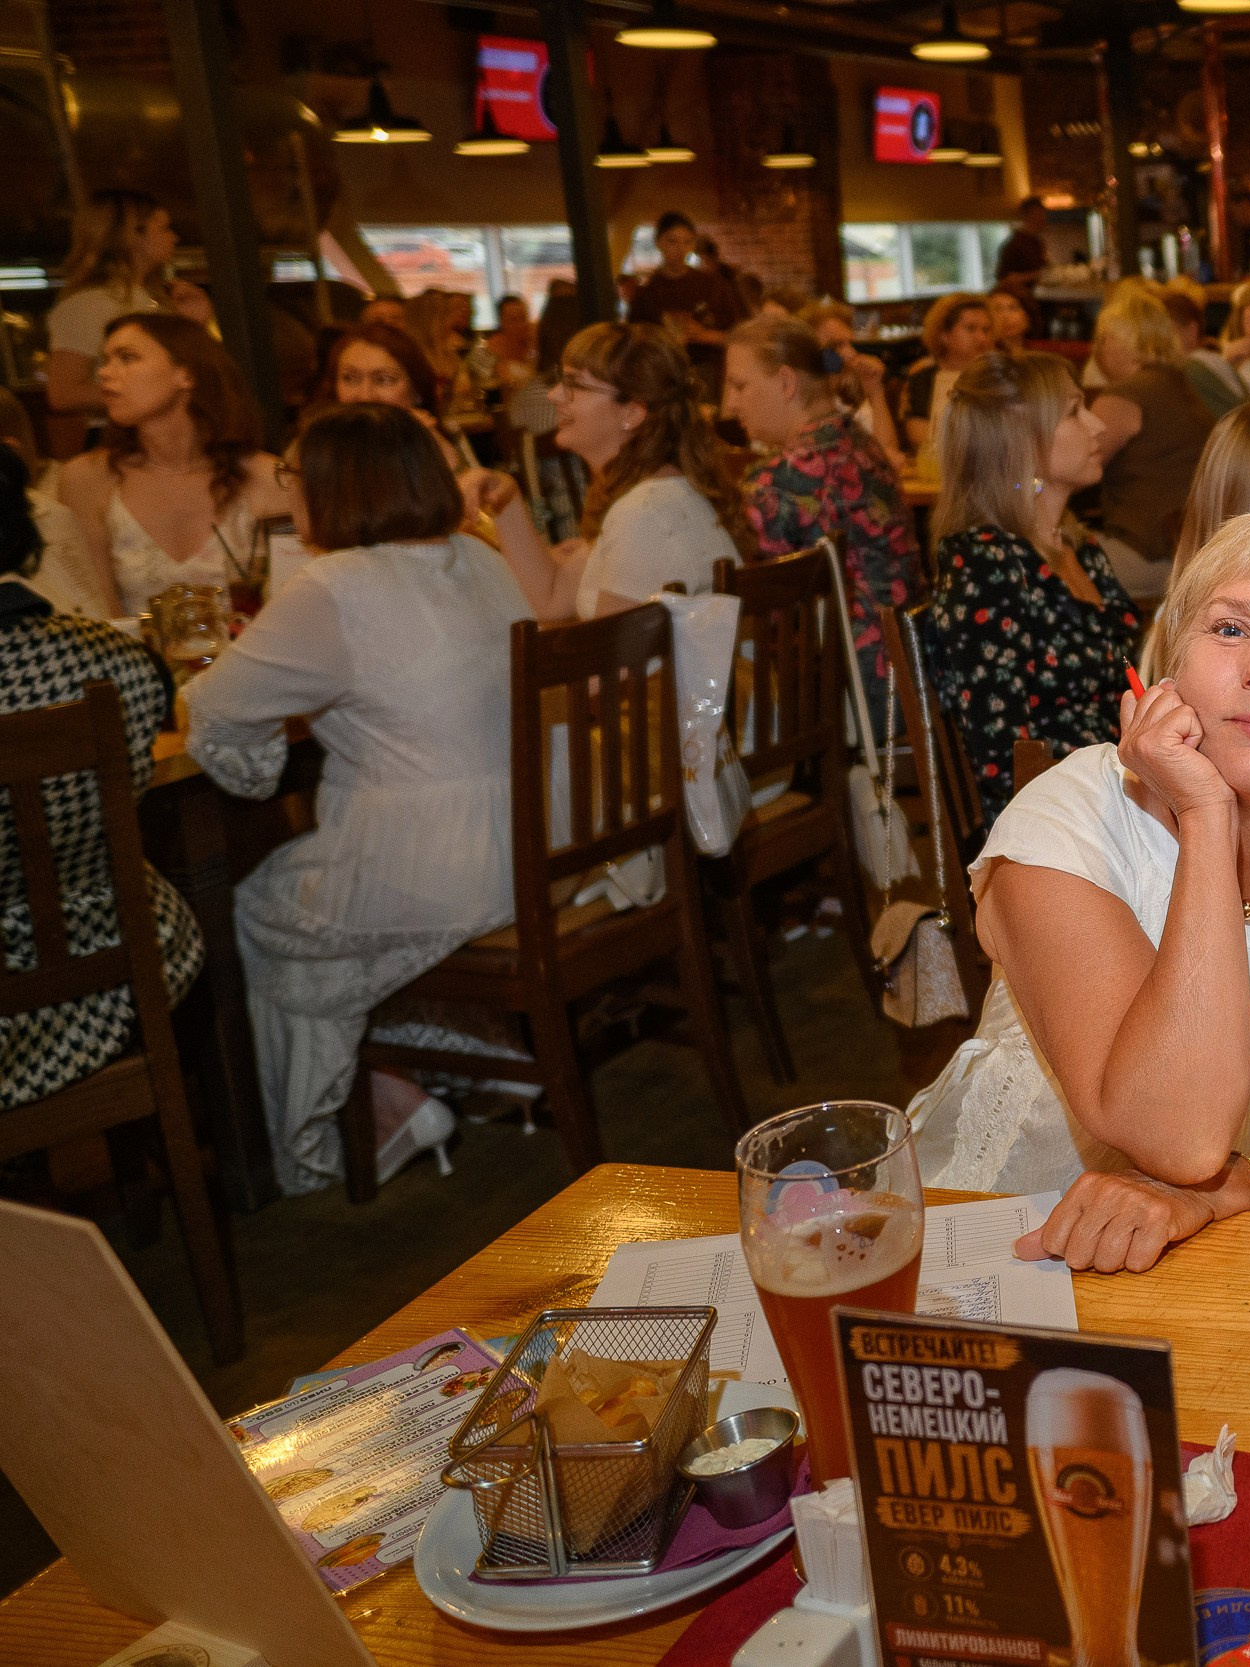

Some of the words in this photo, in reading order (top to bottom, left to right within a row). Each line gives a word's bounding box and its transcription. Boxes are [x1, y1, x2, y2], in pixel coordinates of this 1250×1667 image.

[861, 1330, 998, 1365] ВСТРЕЧАЙТЕ!
[299, 1385, 333, 1403] ПИВО
[862, 1362, 1000, 1409] СЕВЕРО-
[867, 1402, 1008, 1445] НЕМЕЦКИЙ
[874, 1437, 1017, 1504] ПИЛС
[890, 1502, 945, 1525] ЕВЕР
[953, 1506, 1013, 1532] ПИЛС
[895, 1627, 1042, 1661] ЛИМИТИРОВАННОЕ!
